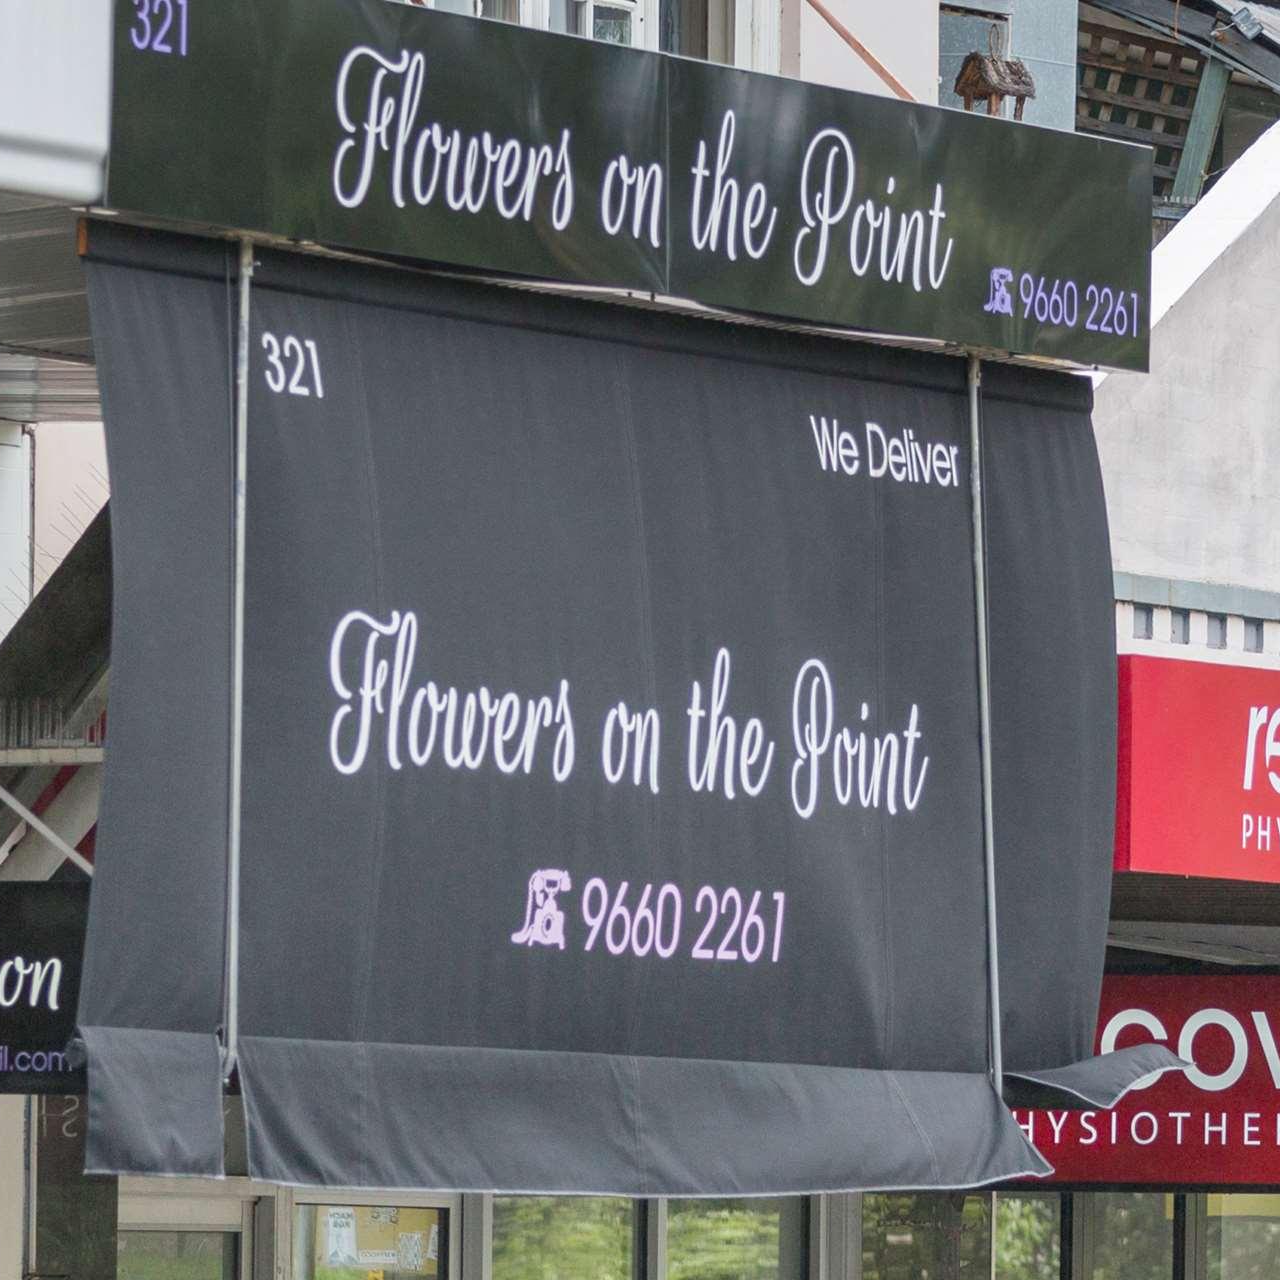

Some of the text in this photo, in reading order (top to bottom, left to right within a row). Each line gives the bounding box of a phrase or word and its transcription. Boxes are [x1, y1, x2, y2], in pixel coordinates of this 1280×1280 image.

[131, 0, 189, 57] 321
[332, 43, 955, 292] Flowers on the Point
[1019, 273, 1140, 338] 9660 2261
[262, 331, 325, 399] 321
[811, 414, 959, 489] We Deliver
[328, 609, 929, 818] Flowers on the Point
[581, 876, 785, 963] 9660 2261
